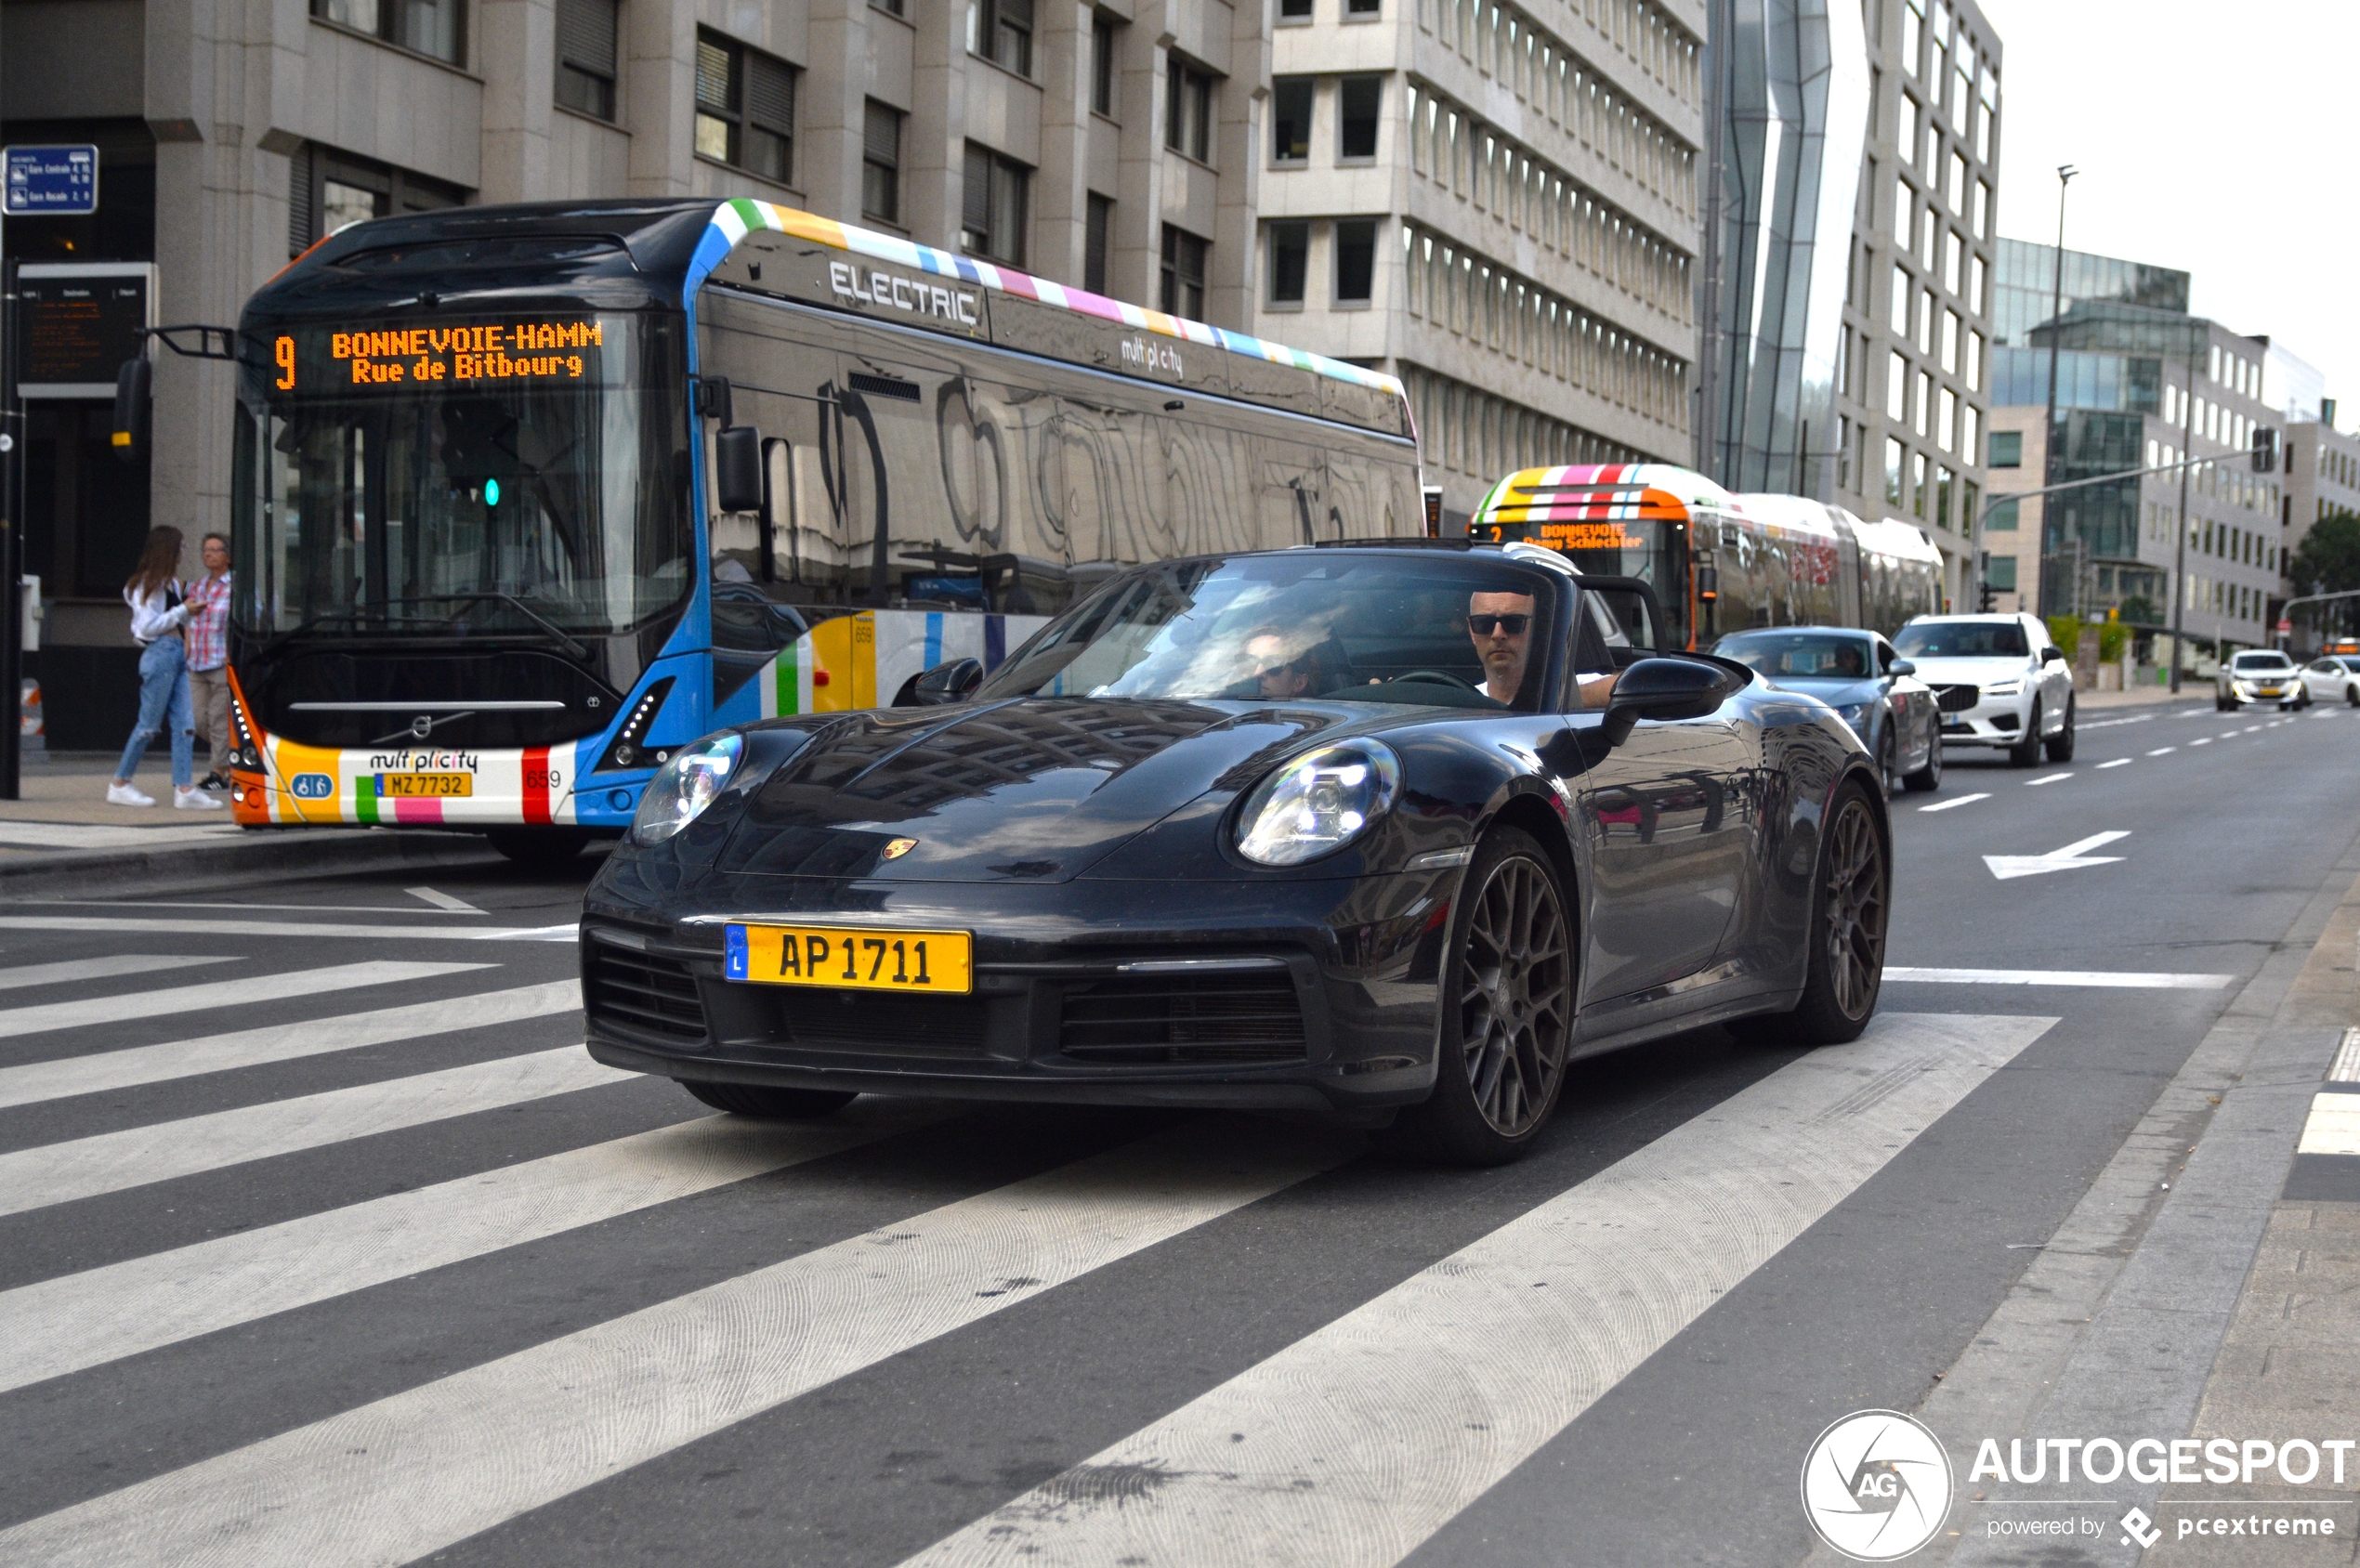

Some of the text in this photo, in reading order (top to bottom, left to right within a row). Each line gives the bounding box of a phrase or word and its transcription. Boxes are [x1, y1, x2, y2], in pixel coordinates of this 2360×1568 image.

[829, 259, 977, 326] ELECTRIC
[332, 320, 603, 359] BONNEVOIE-HAMM
[275, 335, 295, 390] 9
[352, 352, 583, 384] Rue de Bitbourg
[855, 626, 872, 643] 659
[370, 750, 479, 774] multiplicity
[392, 776, 462, 794] MZ 7732
[526, 770, 561, 789] 659
[733, 956, 741, 971] L
[780, 933, 931, 983] AP 1711
